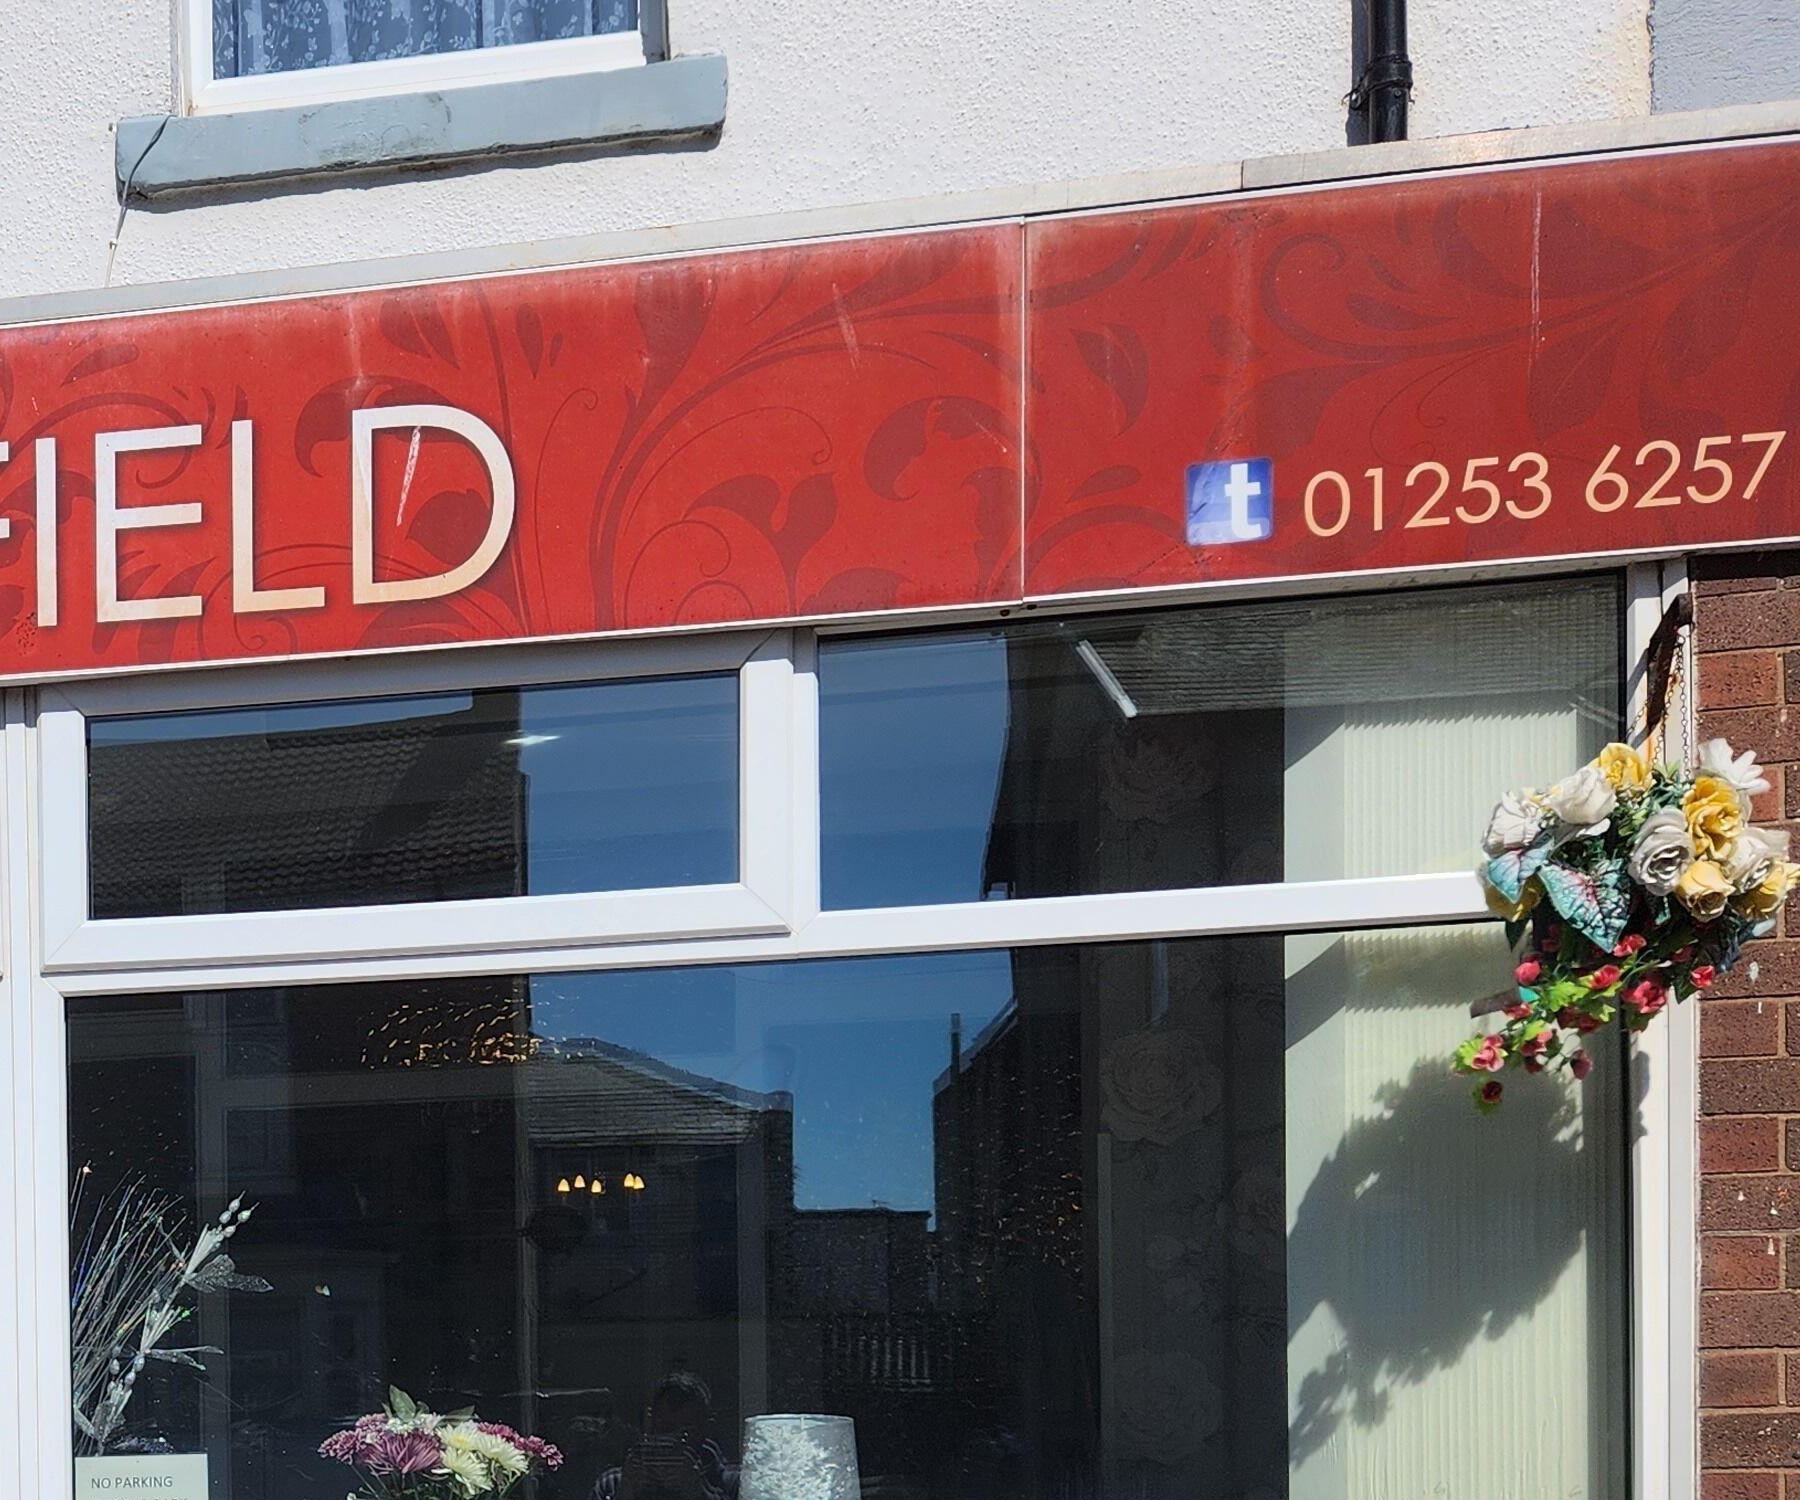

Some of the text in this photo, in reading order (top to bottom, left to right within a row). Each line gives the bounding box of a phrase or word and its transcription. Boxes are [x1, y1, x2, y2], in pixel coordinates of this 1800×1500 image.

[1303, 430, 1788, 538] 01253 6257
[91, 1476, 174, 1489] NO PARKING
